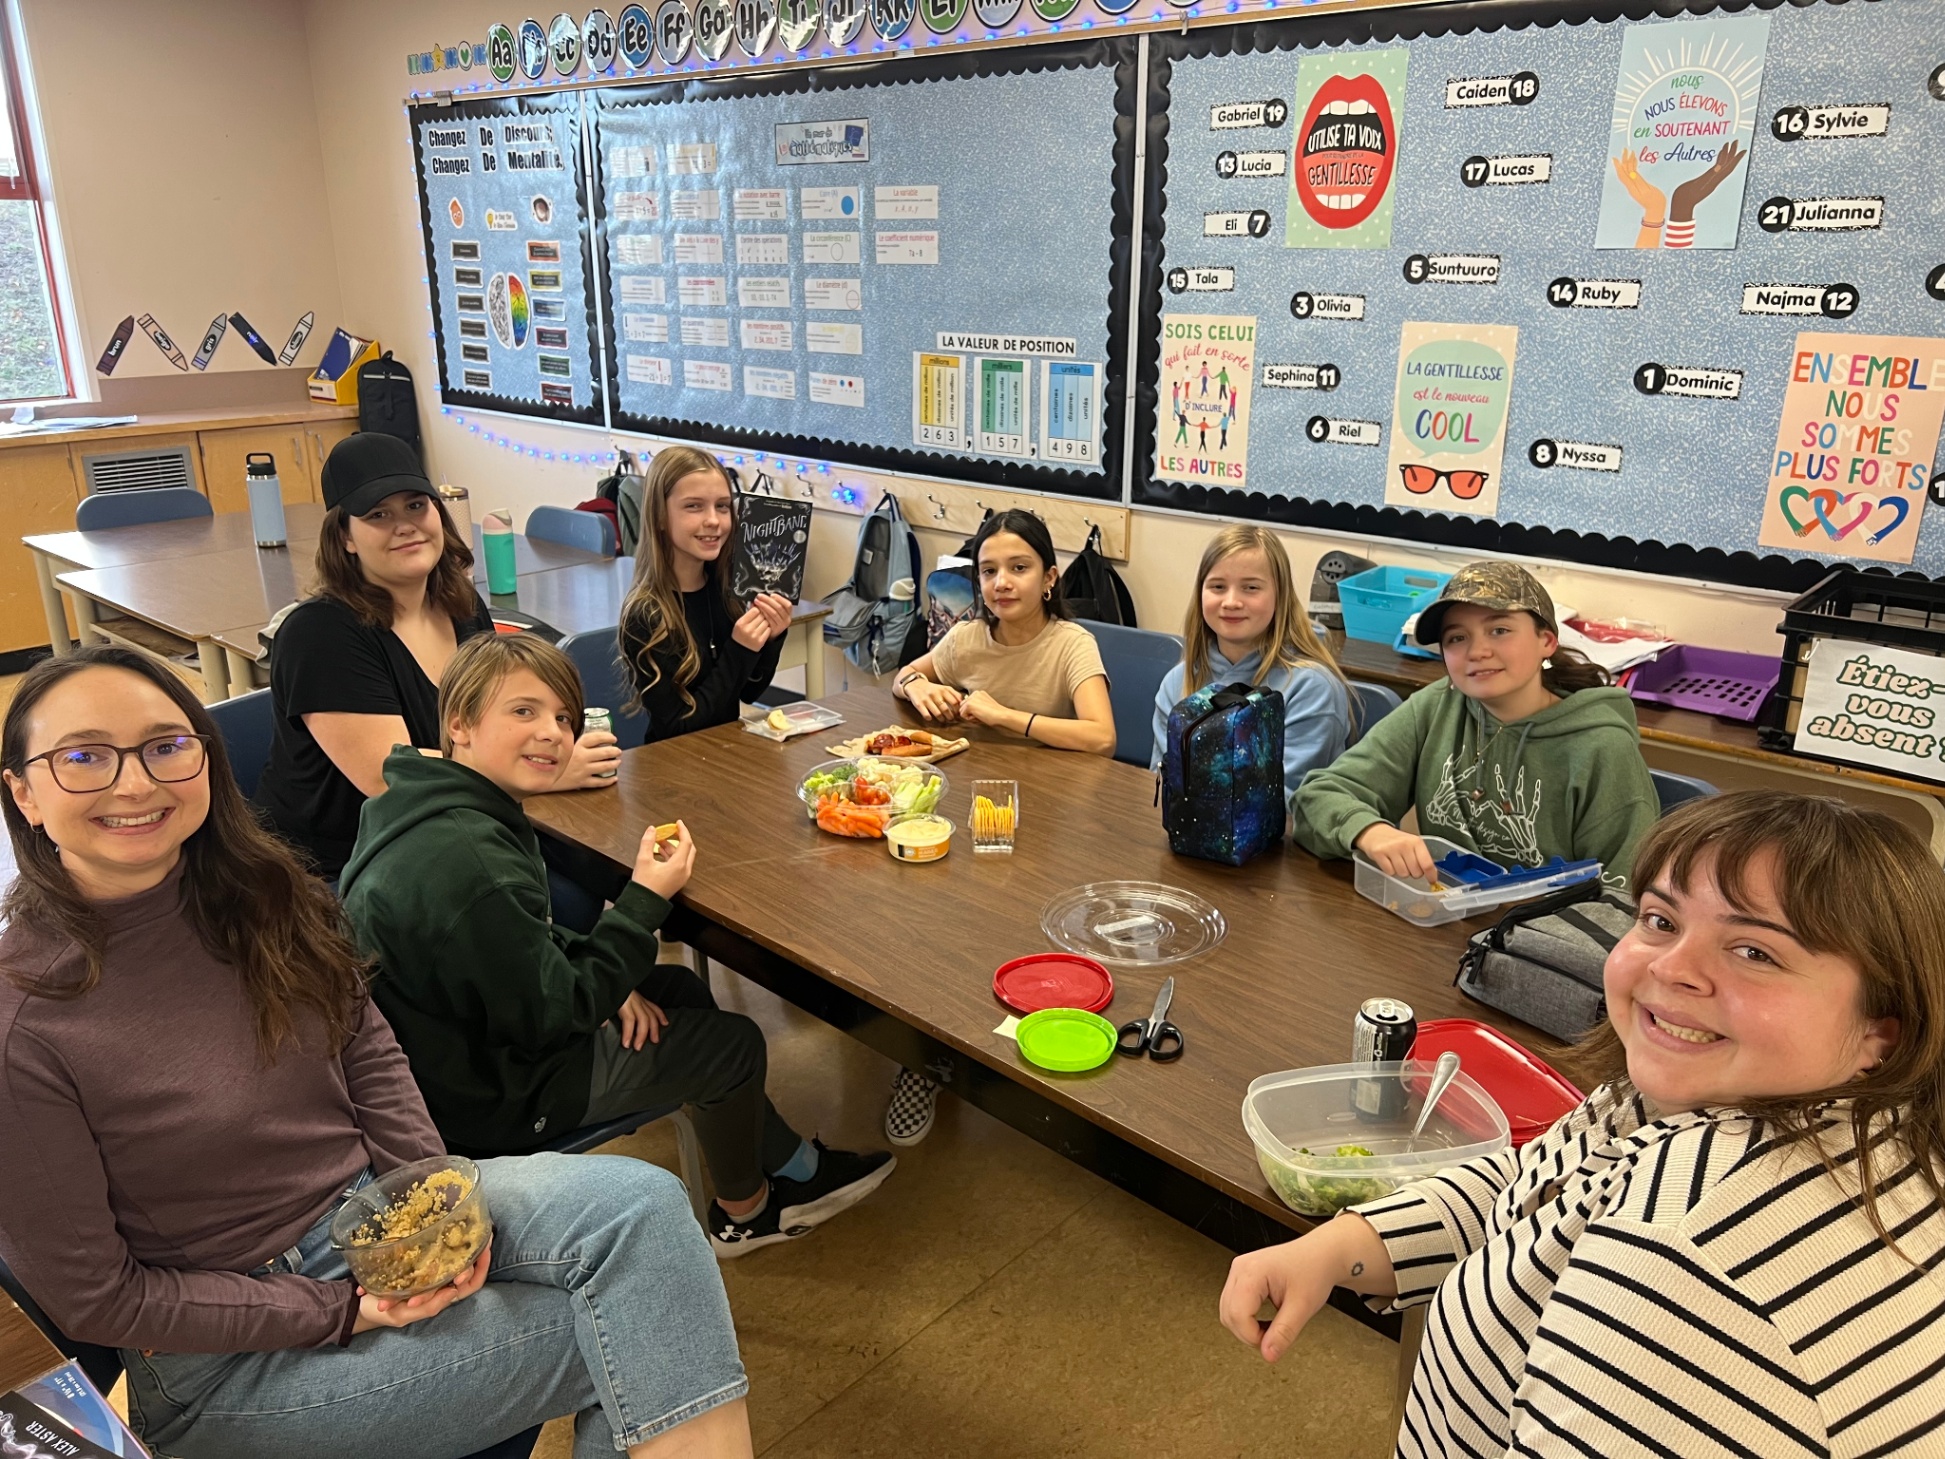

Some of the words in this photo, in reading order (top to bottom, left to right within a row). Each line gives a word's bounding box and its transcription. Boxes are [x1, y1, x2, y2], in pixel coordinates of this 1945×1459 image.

[625, 17, 647, 53] Ee
[664, 13, 685, 48] Ff
[492, 36, 512, 67] Aa
[1456, 85, 1507, 100] Caiden
[1513, 80, 1535, 97] 18
[1671, 74, 1704, 90] nous
[1218, 107, 1261, 122] Gabriel
[1266, 106, 1284, 122] 19
[1644, 97, 1676, 121] NOUS
[1679, 92, 1728, 117] ÉLEVONS
[1634, 126, 1652, 138] en
[1655, 120, 1731, 138] SOUTENANT
[1777, 113, 1804, 134] 16
[1814, 113, 1868, 133] Sylvie
[429, 130, 466, 148] Changez
[480, 127, 494, 145] De
[1308, 123, 1341, 153] UTILISE
[1343, 123, 1356, 147] TA
[1358, 125, 1382, 150] VOIX
[432, 157, 470, 175] Changez
[482, 152, 496, 171] De
[1639, 146, 1660, 164] les
[1663, 142, 1718, 162] Autres
[1218, 157, 1237, 173] 13
[1241, 159, 1272, 172] Lucia
[1308, 161, 1377, 187] GENTILLESSE
[1465, 162, 1487, 181] 17
[1493, 163, 1535, 177] Lucas
[1225, 218, 1237, 231] Eli
[1253, 215, 1266, 234] 7
[1762, 205, 1791, 225] 21
[1796, 204, 1876, 221] Julianna
[1410, 260, 1424, 278] 5
[1427, 261, 1496, 277] Suntuuro
[1170, 273, 1186, 288] 15
[1195, 272, 1218, 285] Tala
[1551, 284, 1574, 302] 14
[1581, 286, 1621, 304] Ruby
[1755, 291, 1816, 309] Najma
[1827, 292, 1853, 311] 12
[1296, 297, 1309, 314] 3
[1317, 298, 1351, 313] Olivia
[1165, 323, 1203, 340] SOIS
[1208, 324, 1254, 342] CELUI
[108, 339, 122, 357] brun
[205, 338, 215, 351] gris
[942, 335, 955, 348] LA
[957, 336, 999, 350] VALEUR
[1003, 339, 1017, 350] DE
[1019, 339, 1075, 354] POSITION
[1165, 352, 1181, 369] qui
[1183, 343, 1202, 360] fait
[1205, 346, 1219, 357] en
[1221, 350, 1251, 371] sorte
[1267, 369, 1315, 386] Sephina
[1319, 369, 1336, 386] 11
[1406, 361, 1421, 376] LA
[1424, 362, 1505, 382] GENTILLESSE
[1642, 368, 1656, 390] 1
[1666, 373, 1734, 392] Dominic
[1413, 387, 1429, 402] est
[1431, 388, 1443, 402] le
[1445, 391, 1490, 404] nouveau
[1825, 389, 1900, 422] NOUS
[1311, 420, 1324, 438] 6
[1338, 424, 1362, 438] Riel
[1415, 408, 1480, 443] COOL
[1801, 421, 1913, 456] SOMMES
[1535, 445, 1550, 463] 8
[1562, 447, 1607, 464] Nyssa
[1160, 455, 1185, 472] LES
[1189, 458, 1243, 479] AUTRES
[1774, 451, 1840, 482] PLUS
[1848, 457, 1928, 491] FORTS
[1845, 693, 1936, 729] vous
[1807, 713, 1937, 758] absent
[25, 1420, 59, 1444] ASTER
[51, 1438, 80, 1457] ALEX
